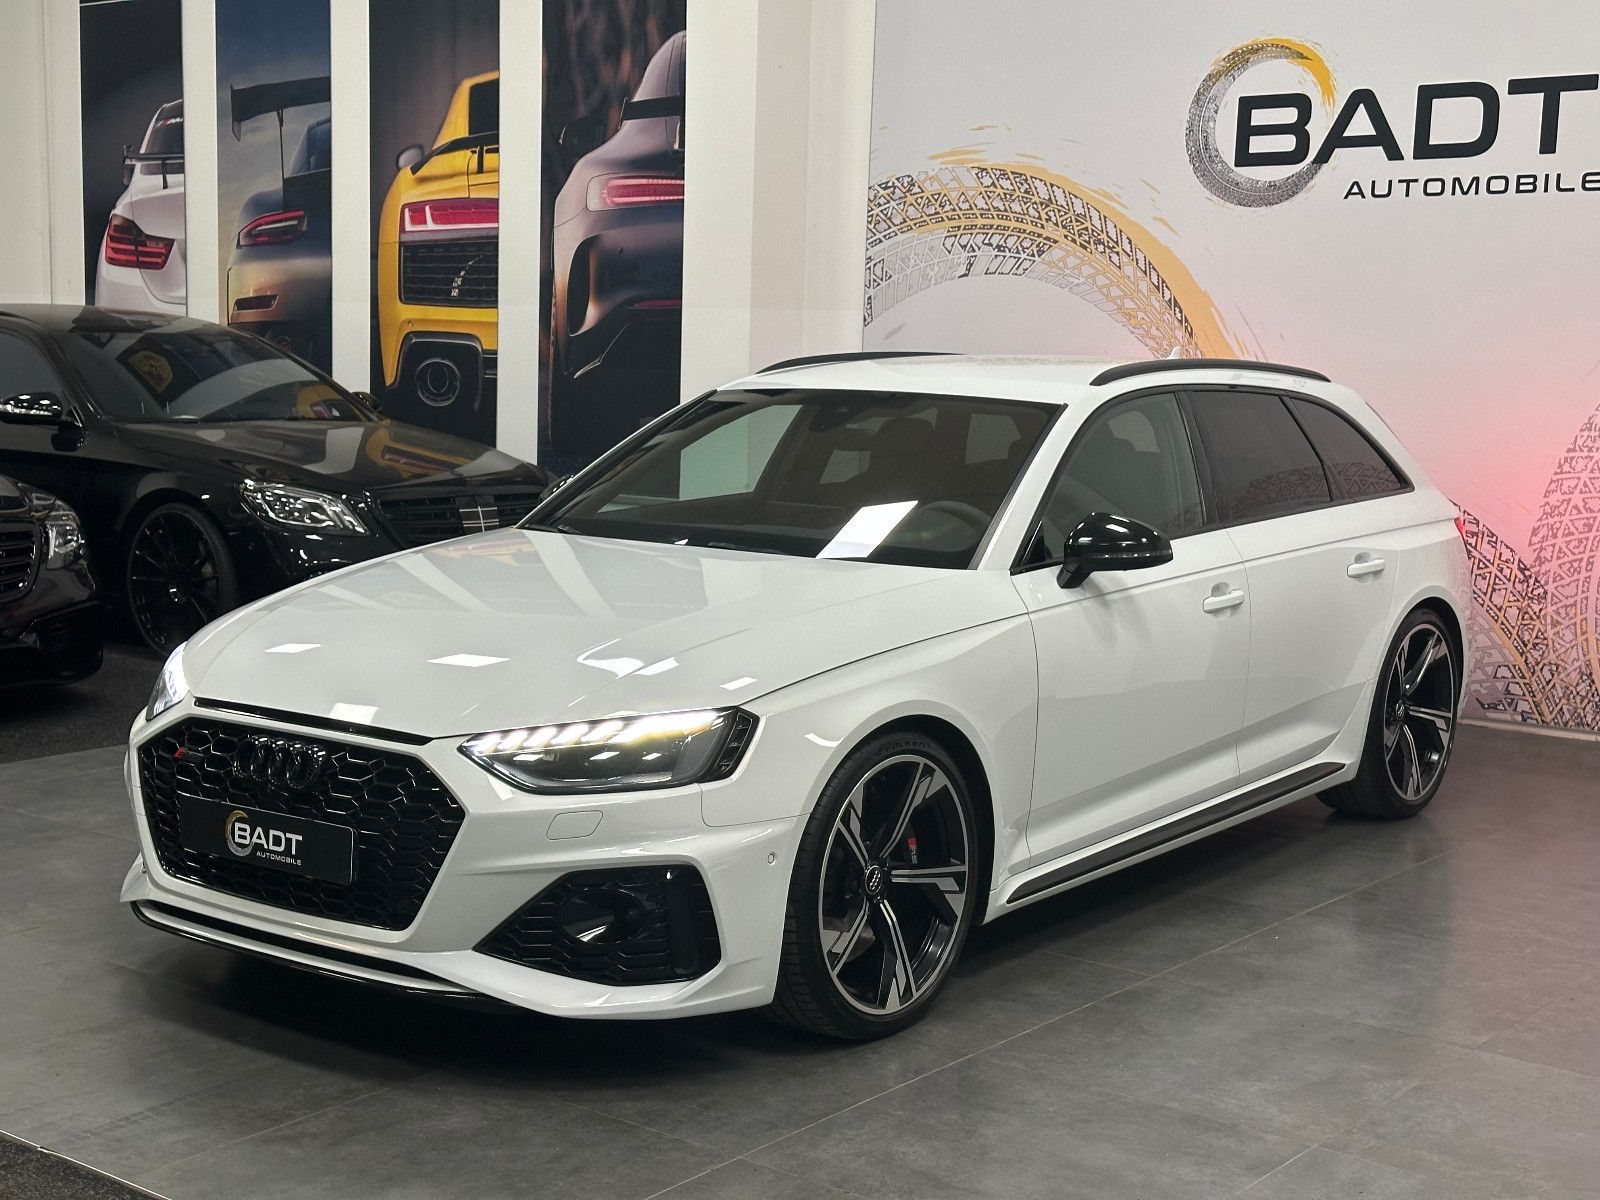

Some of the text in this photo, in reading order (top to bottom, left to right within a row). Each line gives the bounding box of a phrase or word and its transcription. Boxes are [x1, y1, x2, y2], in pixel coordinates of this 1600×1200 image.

[1234, 74, 1599, 167] BADT
[1344, 173, 1600, 199] AUTOMOBILE
[234, 822, 303, 855] BADT
[256, 850, 302, 866] AUTOMOBILE
